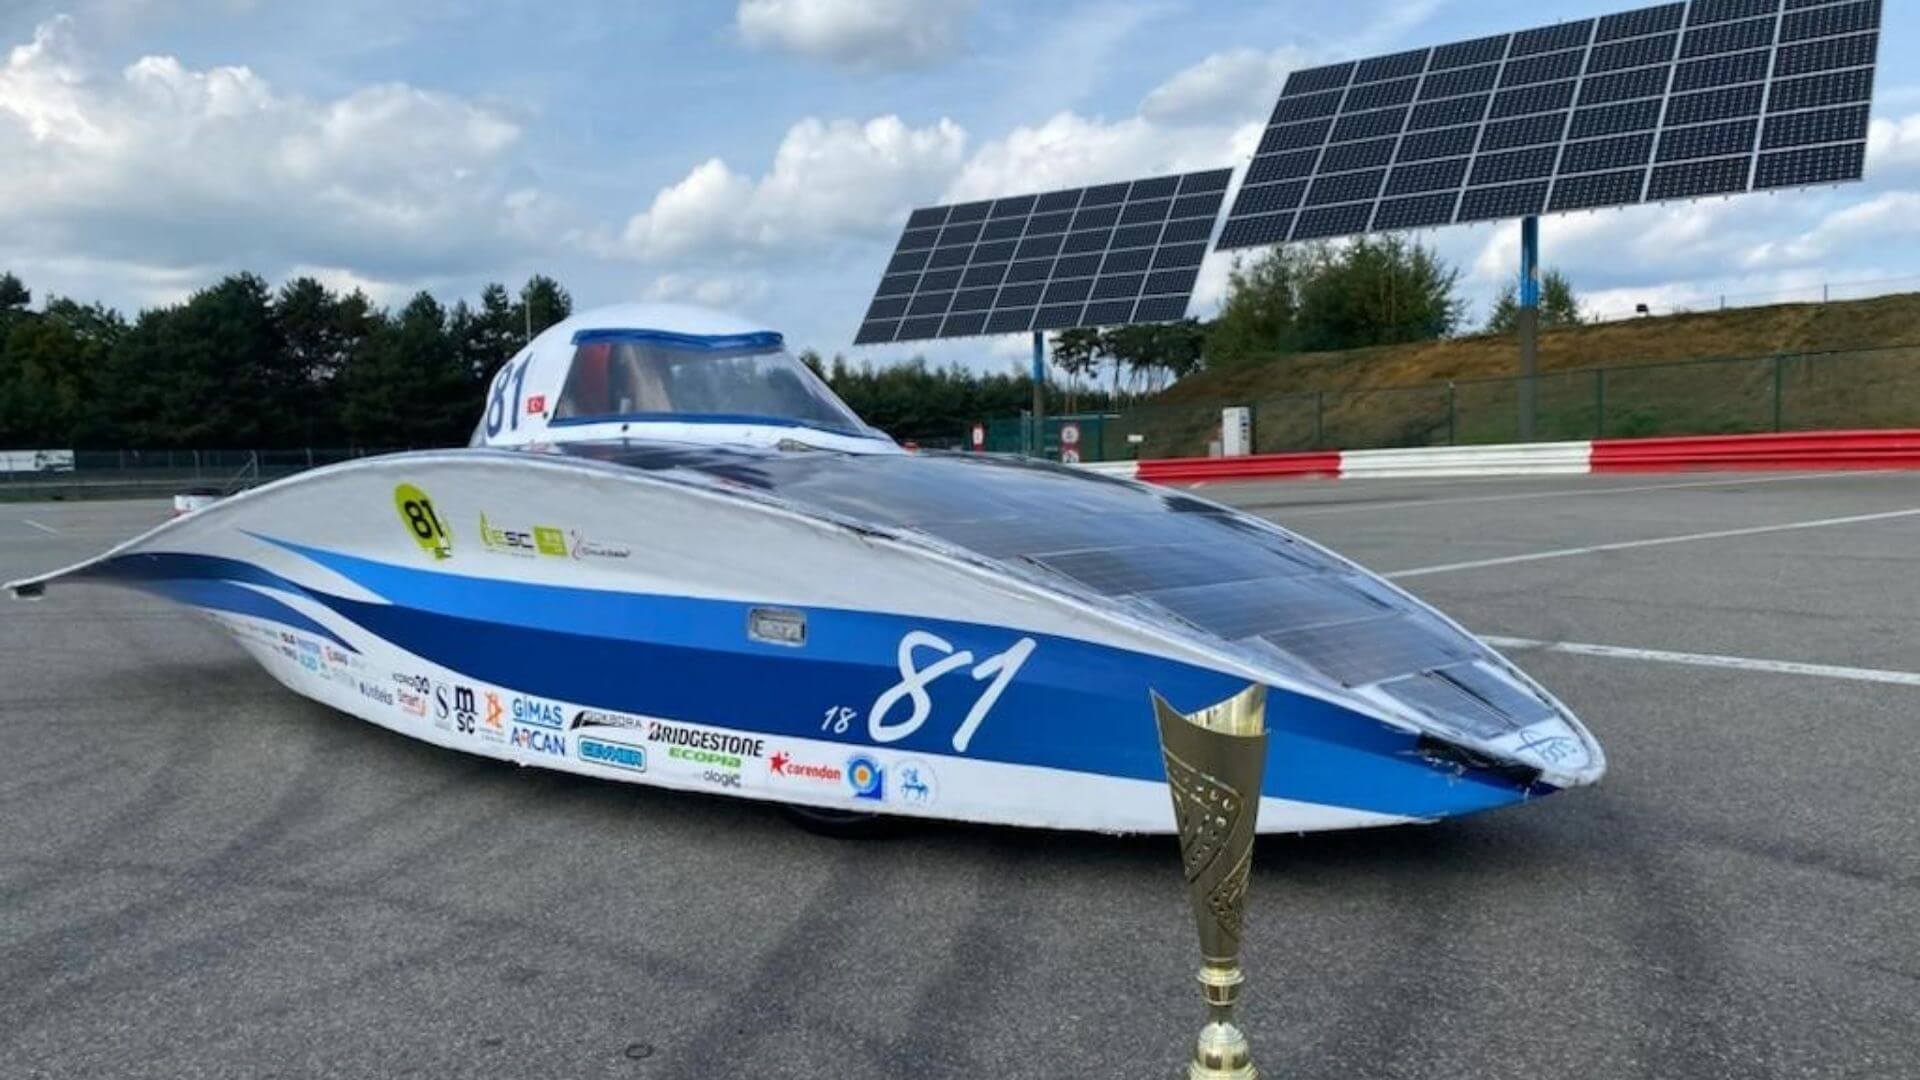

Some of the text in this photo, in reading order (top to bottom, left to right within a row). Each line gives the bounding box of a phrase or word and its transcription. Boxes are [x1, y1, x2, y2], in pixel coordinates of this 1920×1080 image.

[487, 352, 534, 438] 81
[404, 499, 444, 539] 81
[821, 630, 1037, 752] 18 81
[511, 727, 565, 756] ARCAN
[649, 720, 765, 757] BRIDGESTONE
